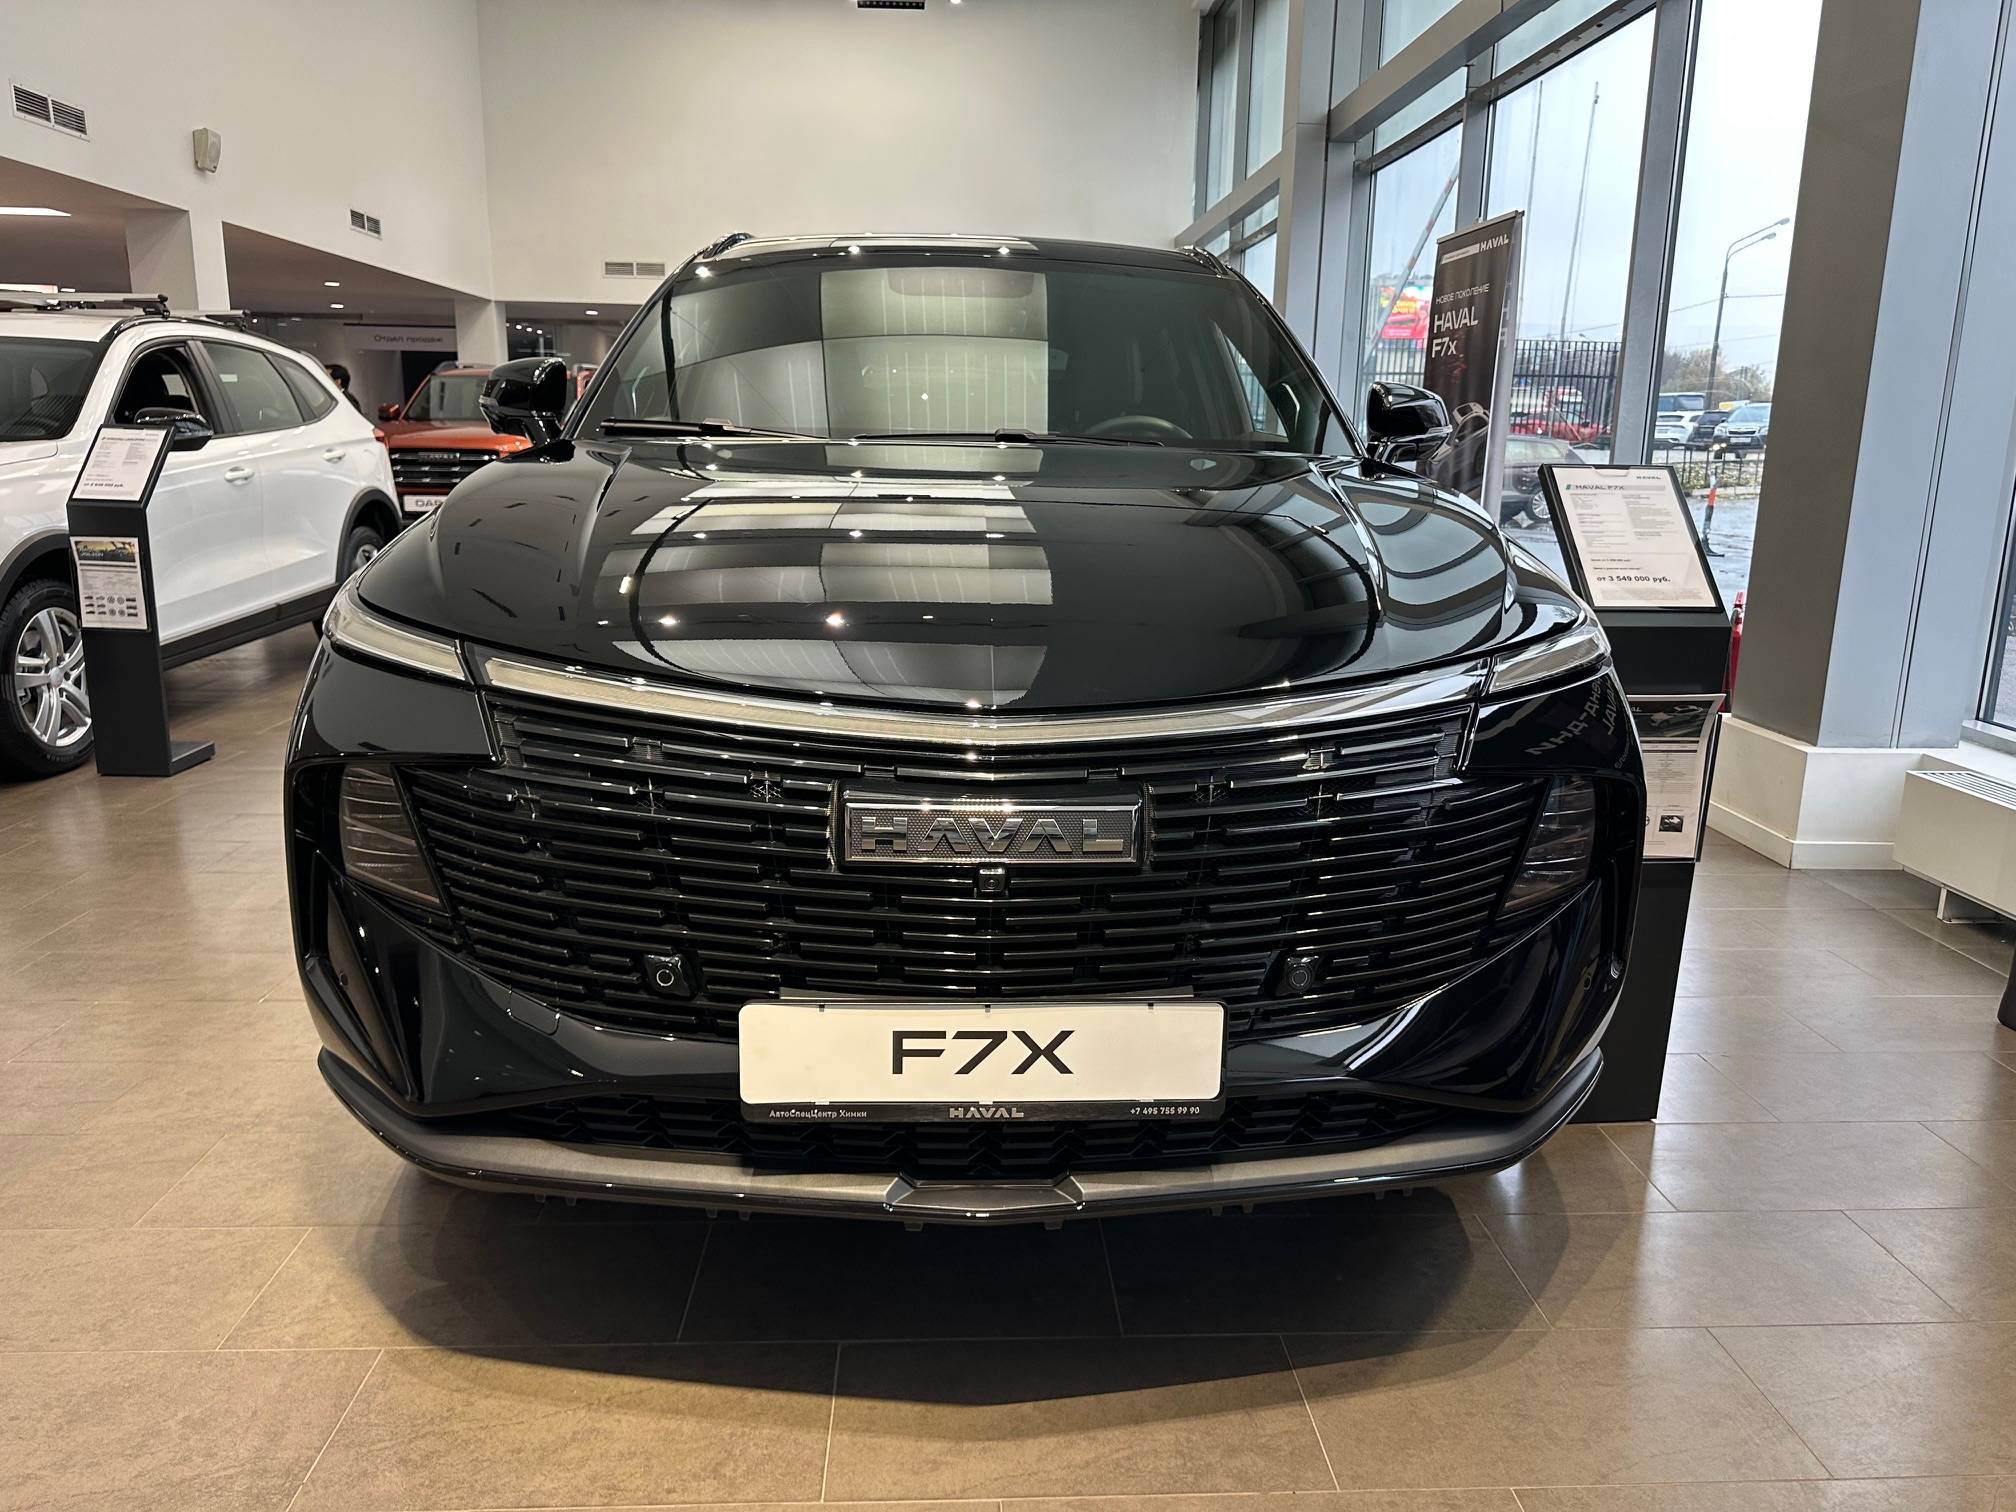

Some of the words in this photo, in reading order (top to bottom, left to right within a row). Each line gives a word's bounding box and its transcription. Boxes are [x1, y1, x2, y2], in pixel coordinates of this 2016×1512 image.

[1480, 234, 1509, 252] HAVAL
[1435, 292, 1455, 304] НОВОЕ
[1455, 283, 1490, 300] ПОКОЛЕНИЕ
[1433, 306, 1479, 333] HAVAL
[861, 816, 1124, 852] HAVAL
[892, 1030, 1076, 1075] F7X
[769, 1109, 836, 1119] АвтоСпецЦентр
[839, 1109, 867, 1118] Химки
[949, 1108, 1024, 1118] HAVAL
[1130, 1106, 1141, 1115] +7
[1142, 1106, 1158, 1115] 495
[1160, 1106, 1175, 1115] 755
[1177, 1106, 1188, 1114] 99
[1189, 1106, 1200, 1114] 90
